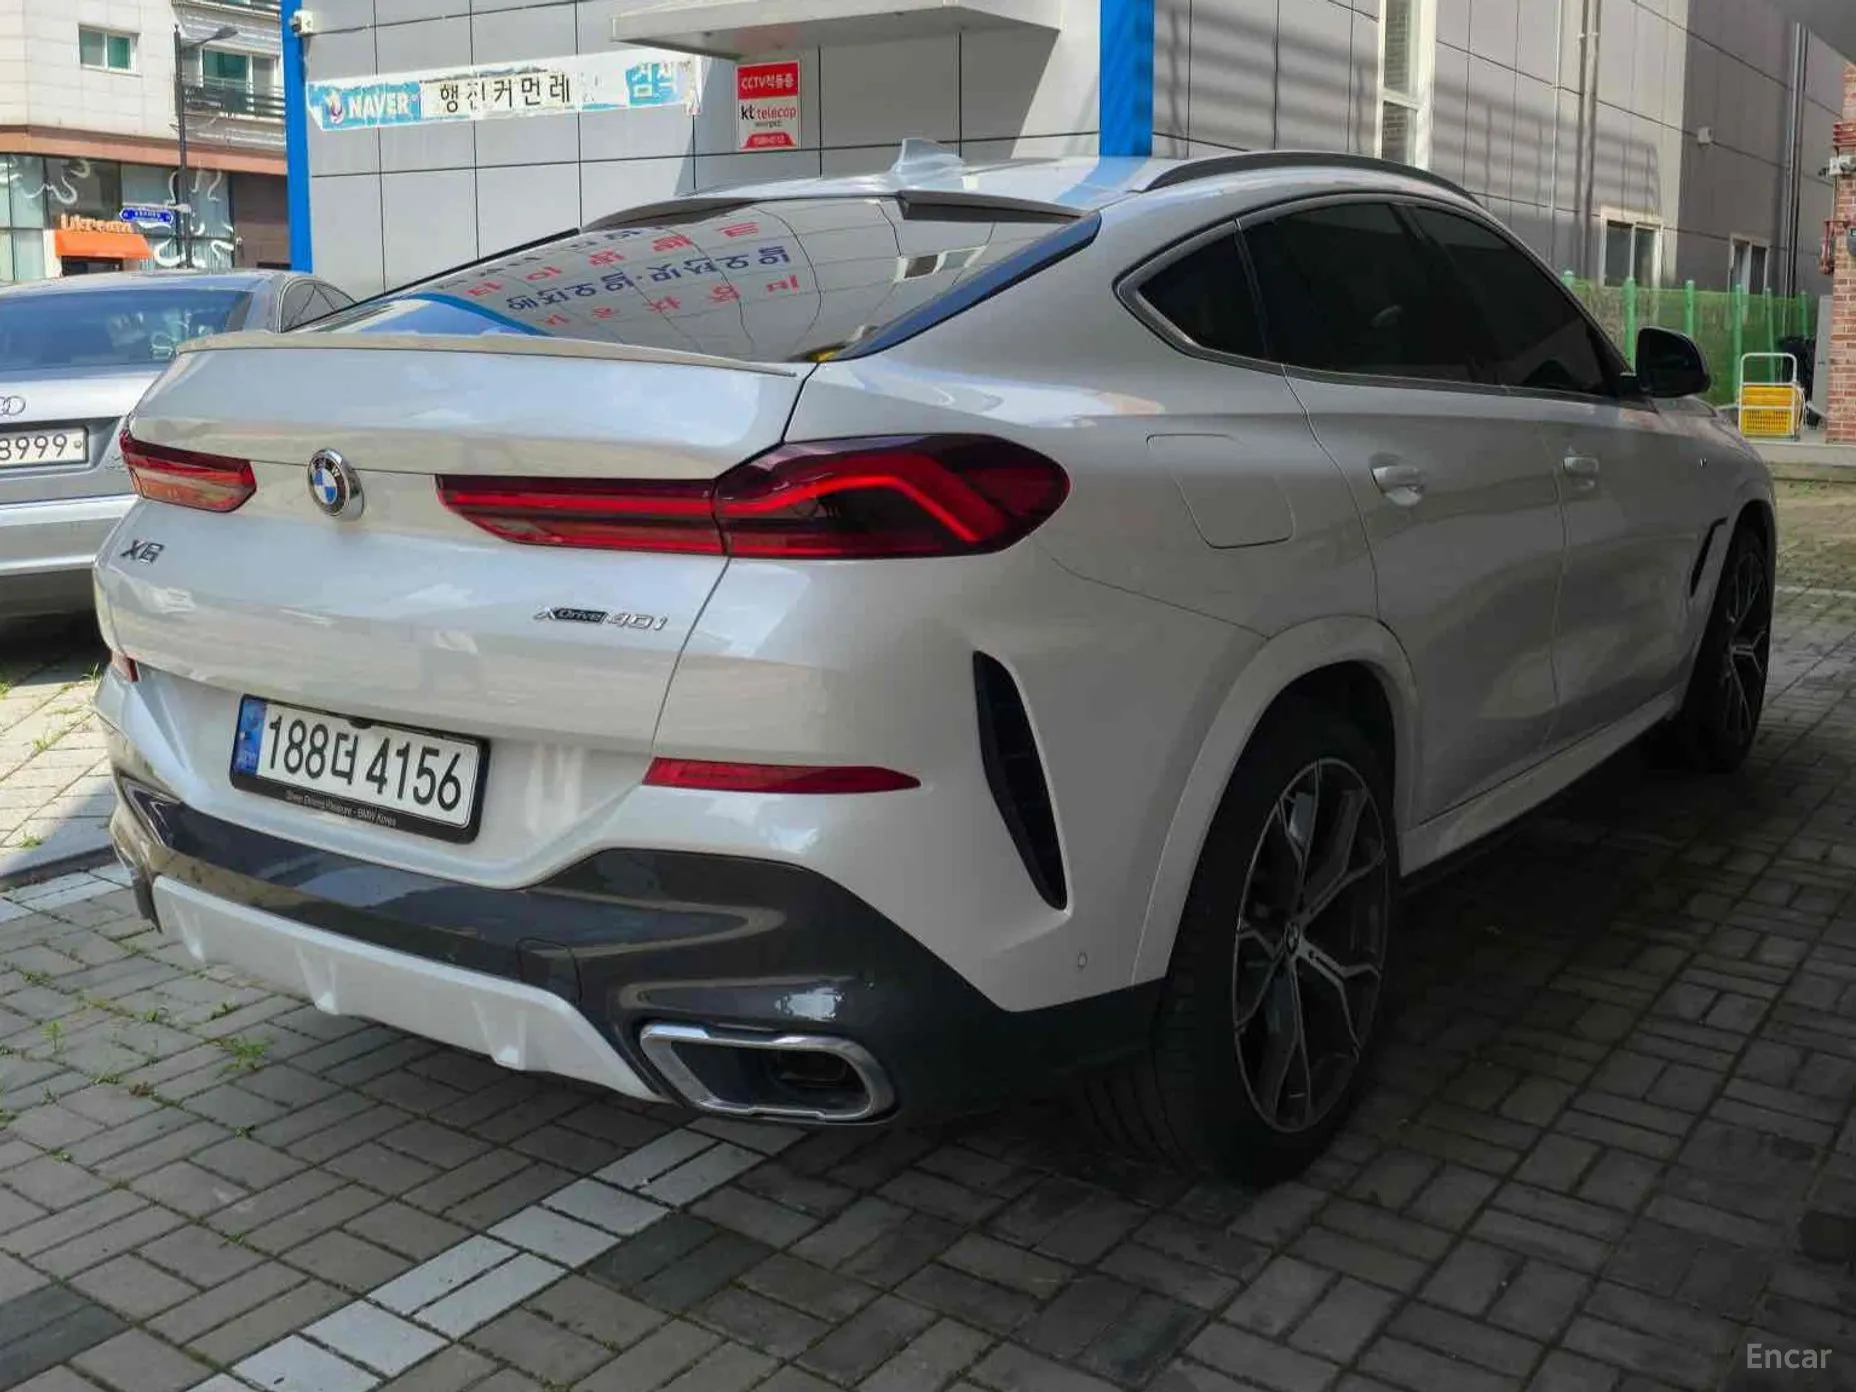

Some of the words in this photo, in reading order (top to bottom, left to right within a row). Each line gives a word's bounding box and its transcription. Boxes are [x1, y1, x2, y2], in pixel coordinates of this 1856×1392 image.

[347, 92, 409, 119] NAVER
[741, 104, 755, 120] kt
[756, 106, 797, 120] telecop
[120, 539, 164, 563] X6
[267, 715, 359, 786] 188더
[366, 737, 462, 812] 4156
